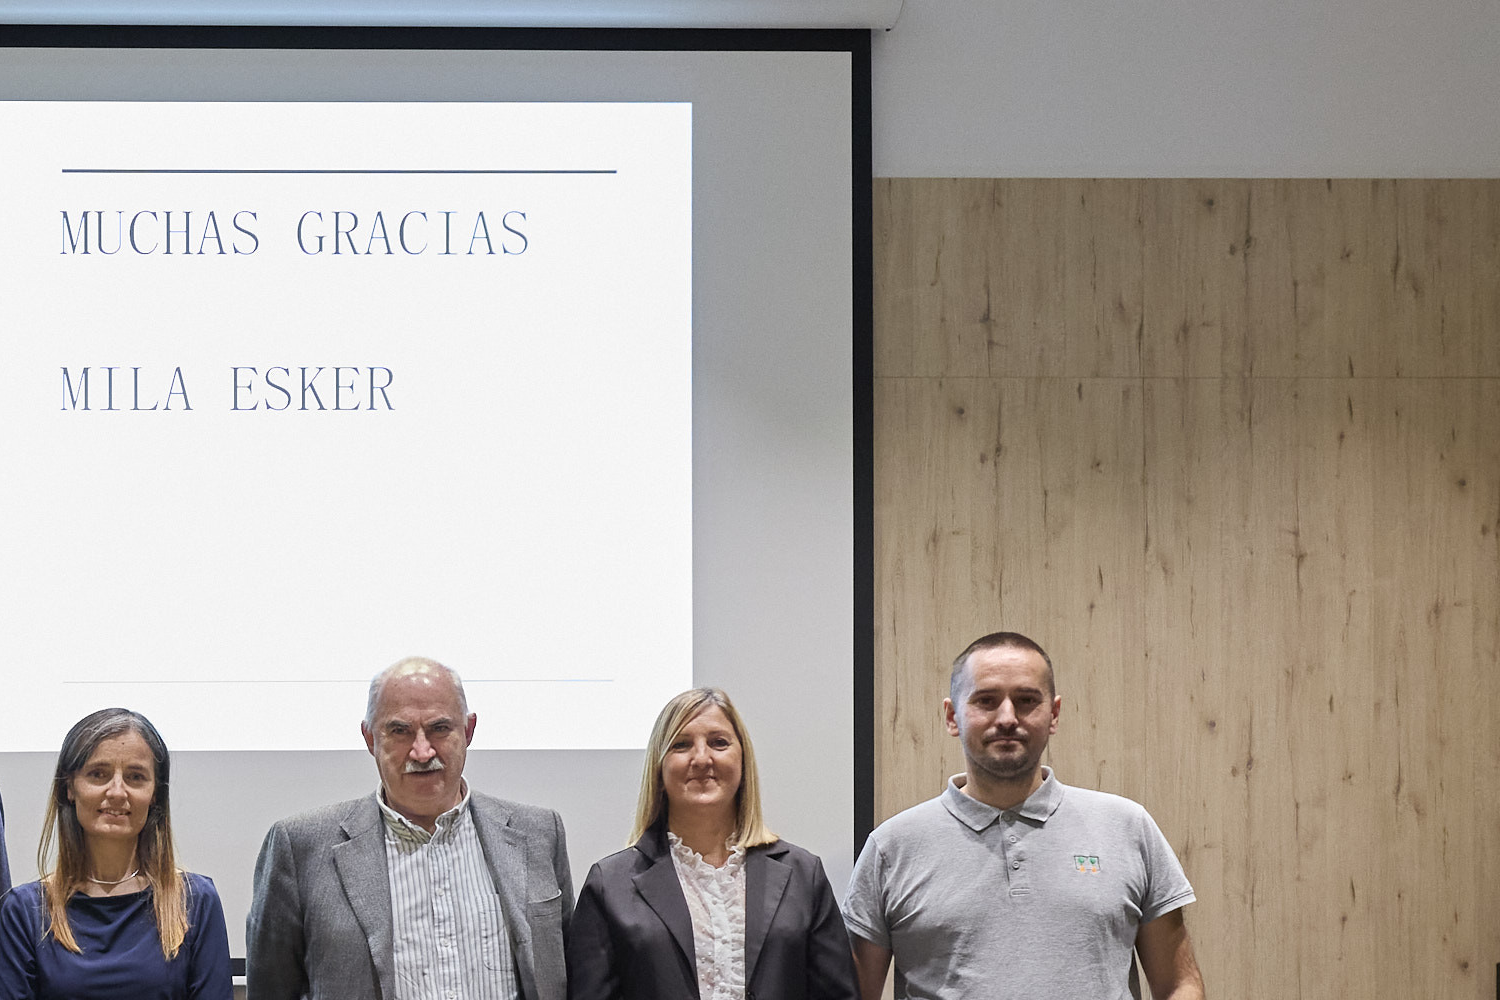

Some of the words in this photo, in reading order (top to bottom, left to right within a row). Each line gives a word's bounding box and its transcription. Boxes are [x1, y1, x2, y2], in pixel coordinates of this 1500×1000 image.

[60, 210, 259, 255] MUCHAS
[297, 210, 529, 255] GRACIAS
[60, 366, 194, 411] MILA
[230, 366, 396, 411] ESKER
